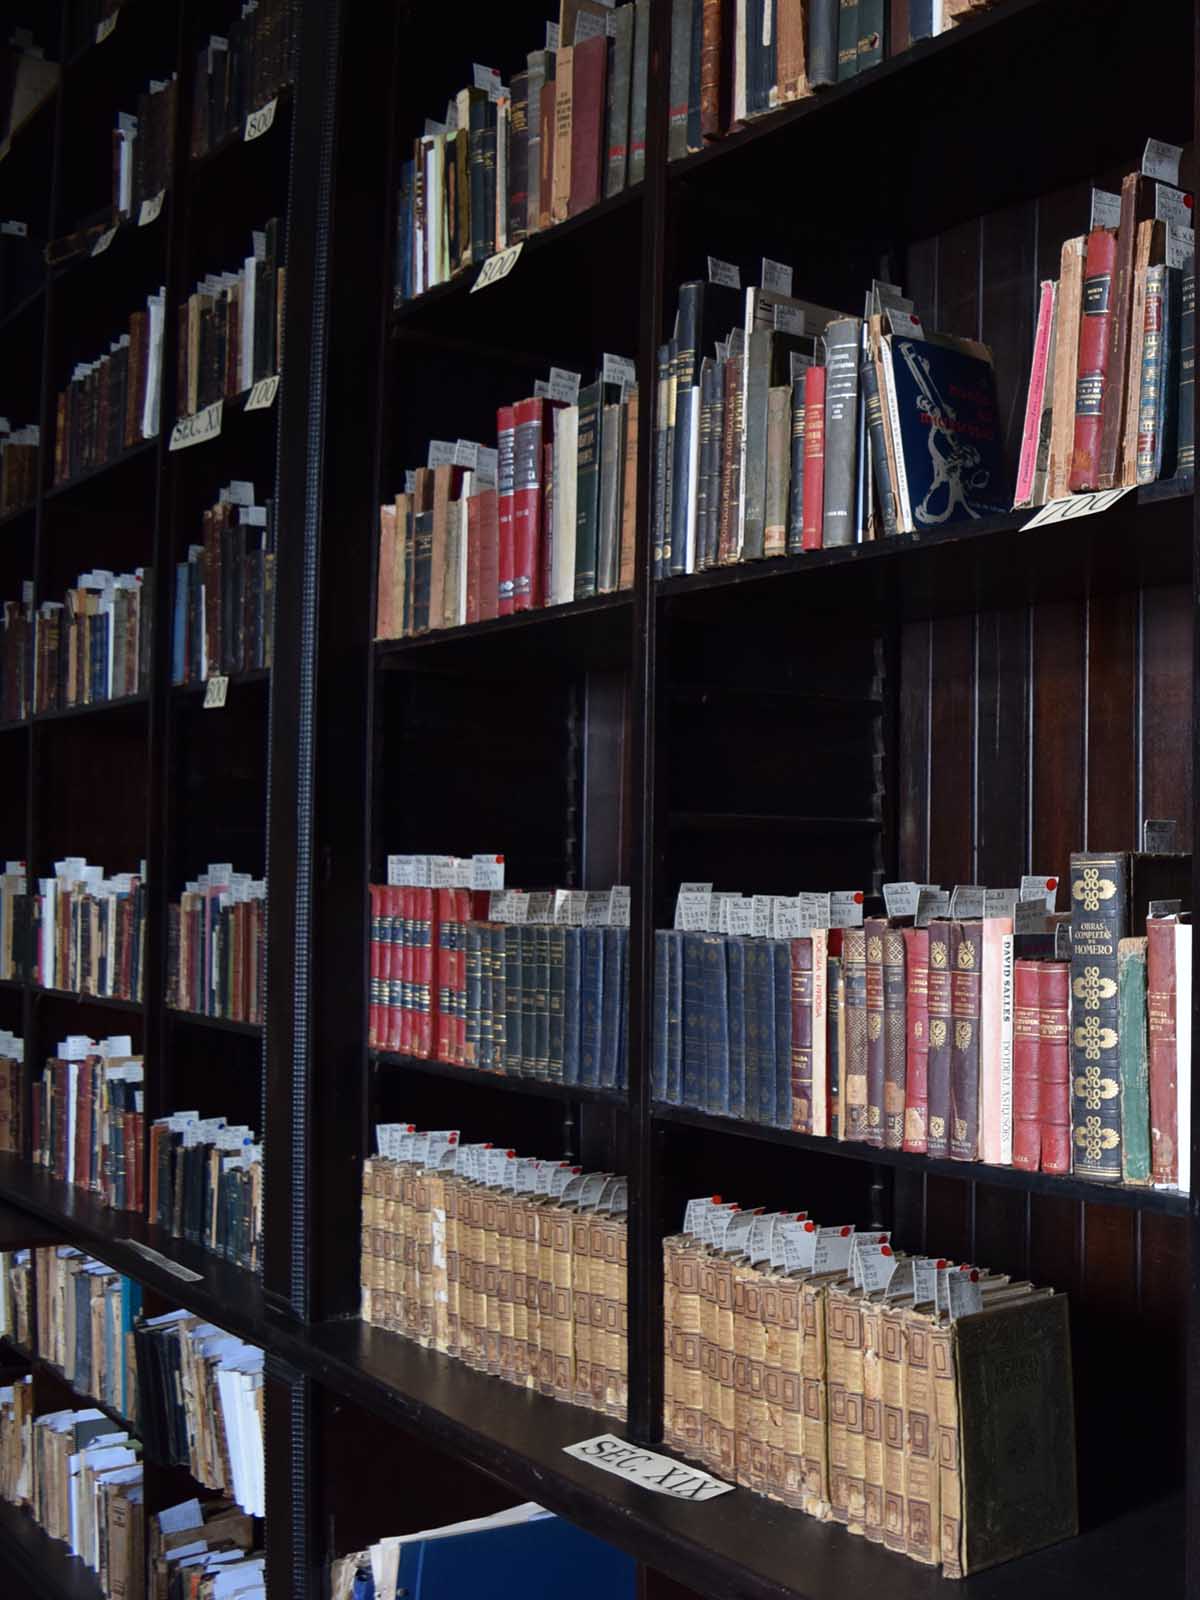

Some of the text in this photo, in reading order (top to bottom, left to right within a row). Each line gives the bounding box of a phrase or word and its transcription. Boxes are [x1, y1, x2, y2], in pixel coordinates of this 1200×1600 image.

[476, 251, 518, 288] 800
[1035, 488, 1127, 525] 700
[1074, 929, 1113, 940] COMPLETAS
[1080, 922, 1105, 931] OBRAS
[1074, 944, 1113, 956] HOMERO
[1002, 941, 1011, 1023] DAVID SALLES
[580, 1440, 721, 1499] SEC. XIX
